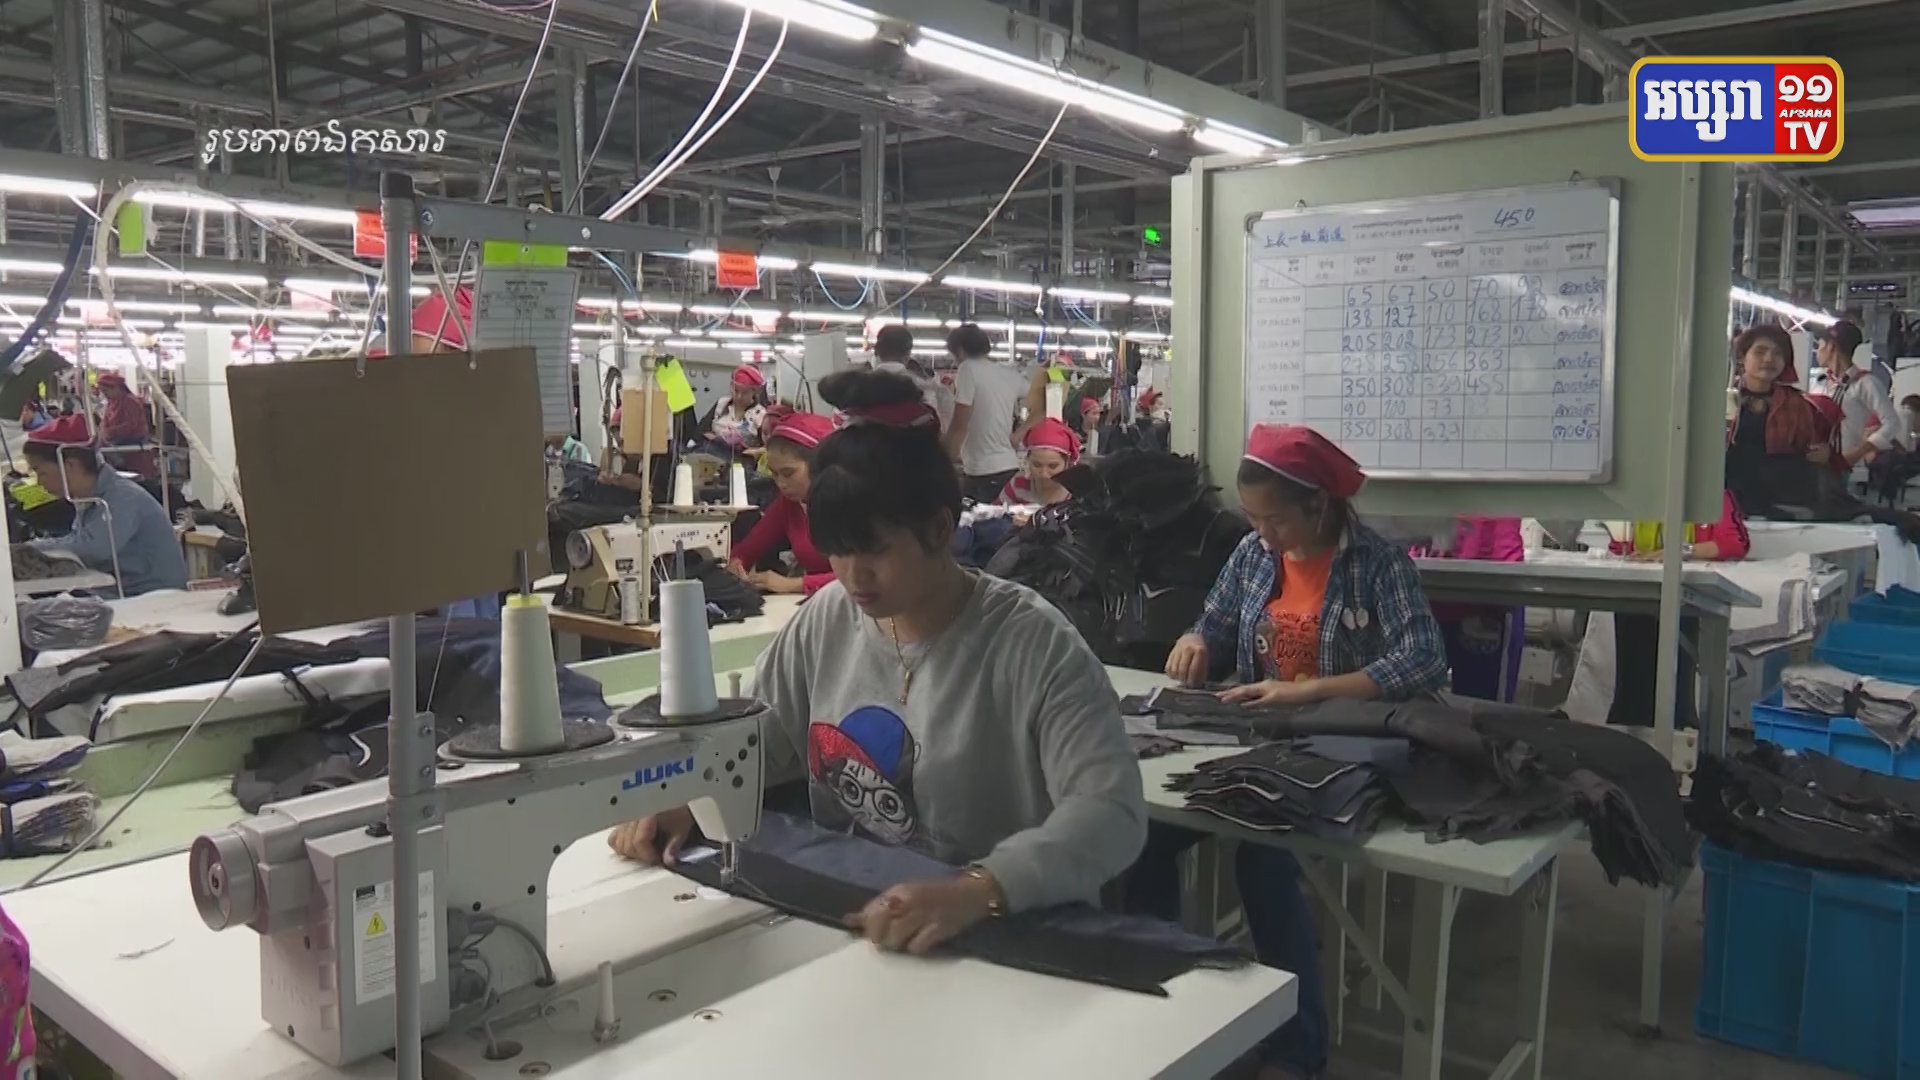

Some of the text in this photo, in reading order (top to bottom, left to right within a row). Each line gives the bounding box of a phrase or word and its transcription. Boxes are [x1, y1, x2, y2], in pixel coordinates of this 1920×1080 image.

[1494, 207, 1536, 228] 450
[1346, 286, 1373, 308] 65
[1387, 284, 1417, 304] 67
[1427, 279, 1456, 302] 50
[1345, 308, 1373, 329] 138
[1384, 304, 1418, 328] 127
[1342, 332, 1377, 353] 205
[1465, 349, 1504, 372] 363
[1343, 377, 1377, 398] 350
[1383, 374, 1416, 396] 308
[1343, 400, 1367, 416] 90
[1342, 420, 1377, 440] 350
[622, 756, 694, 791] JUKI
